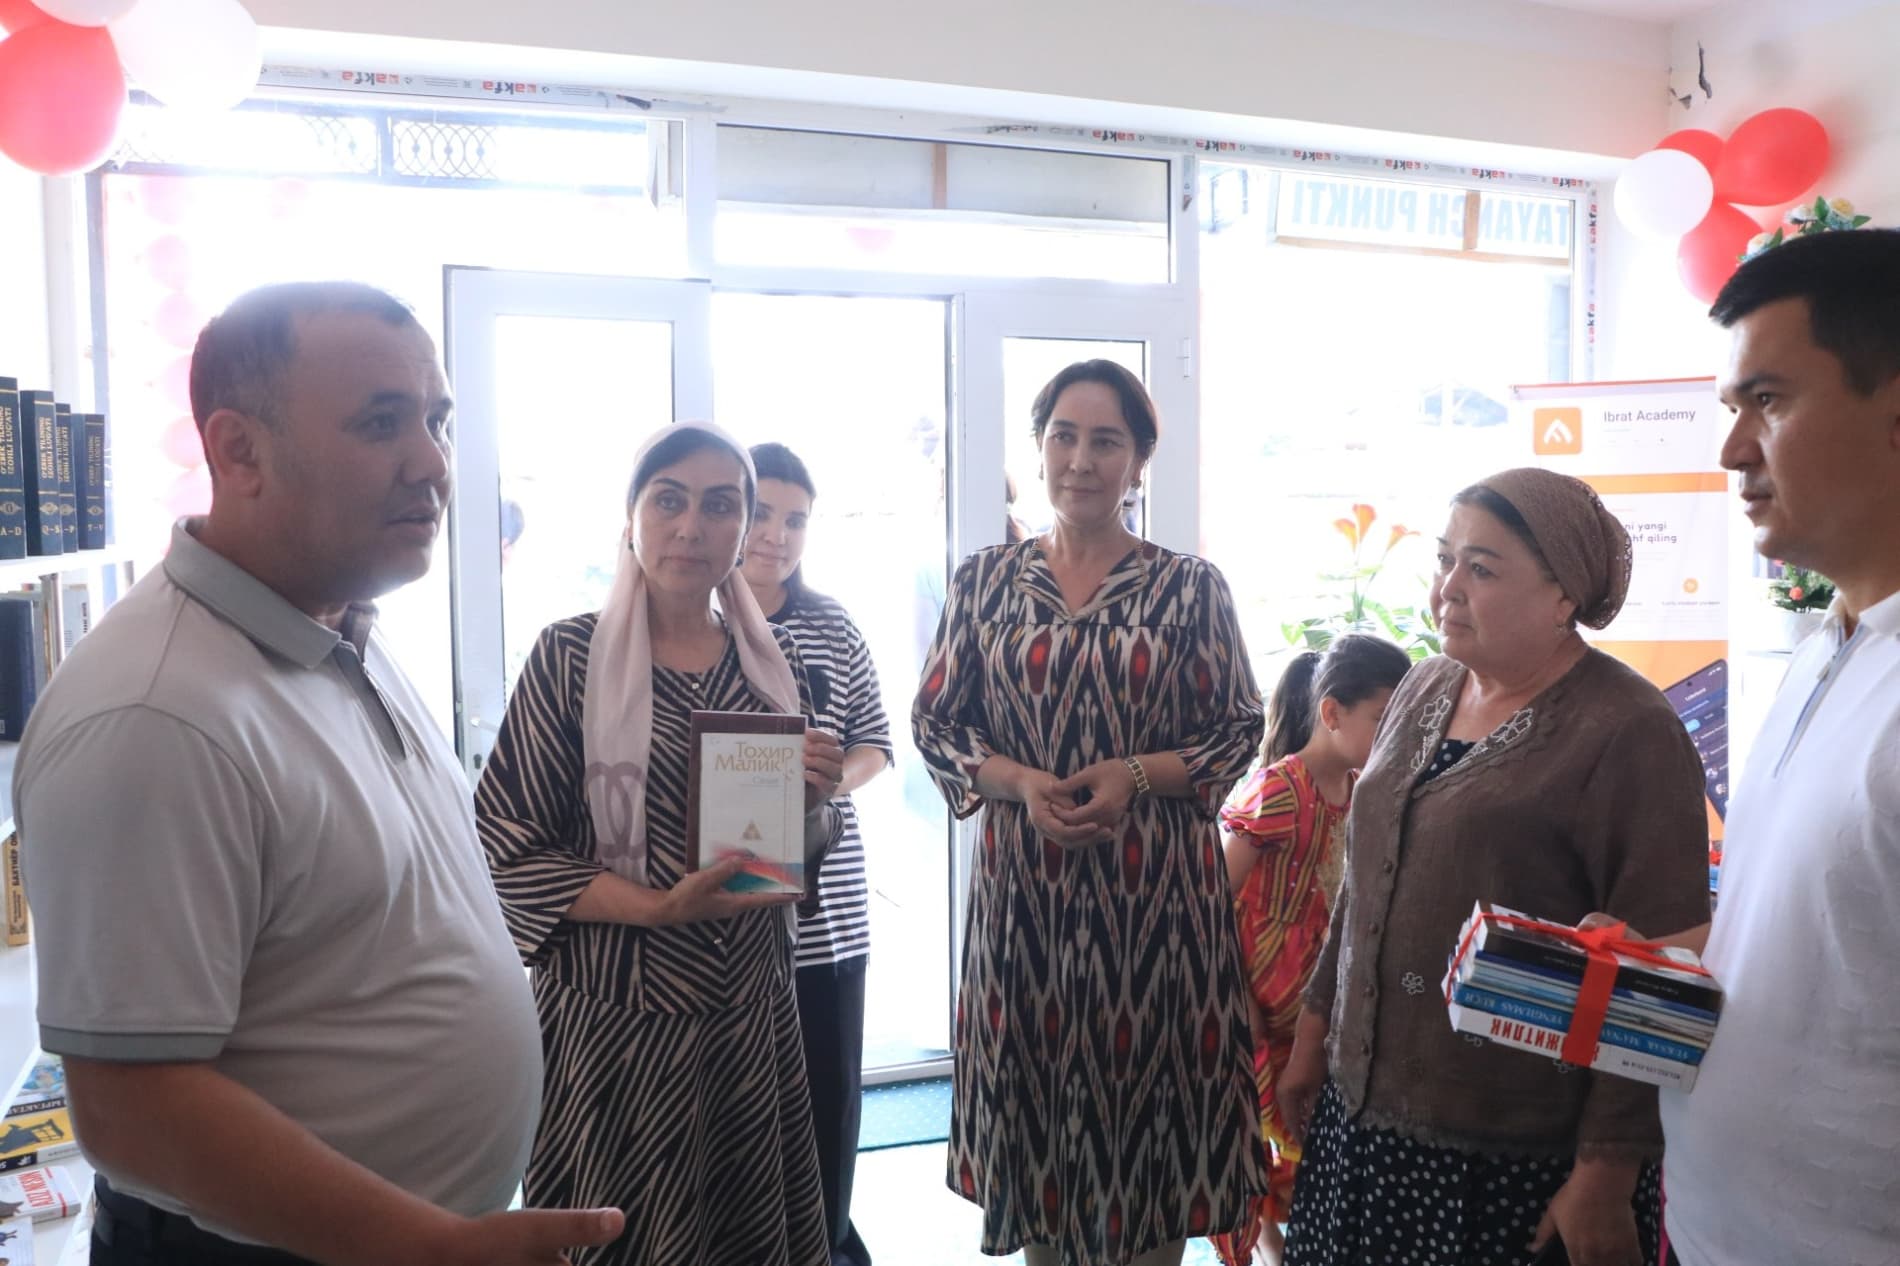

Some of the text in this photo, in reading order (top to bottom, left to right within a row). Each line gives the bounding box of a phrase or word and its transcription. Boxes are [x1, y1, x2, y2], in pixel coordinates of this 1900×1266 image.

[1603, 409, 1697, 423] Ibrat Academy
[1637, 521, 1667, 532] yangi
[1647, 534, 1678, 545] qiling
[735, 742, 795, 764] Тохир
[714, 753, 782, 773] Малик
